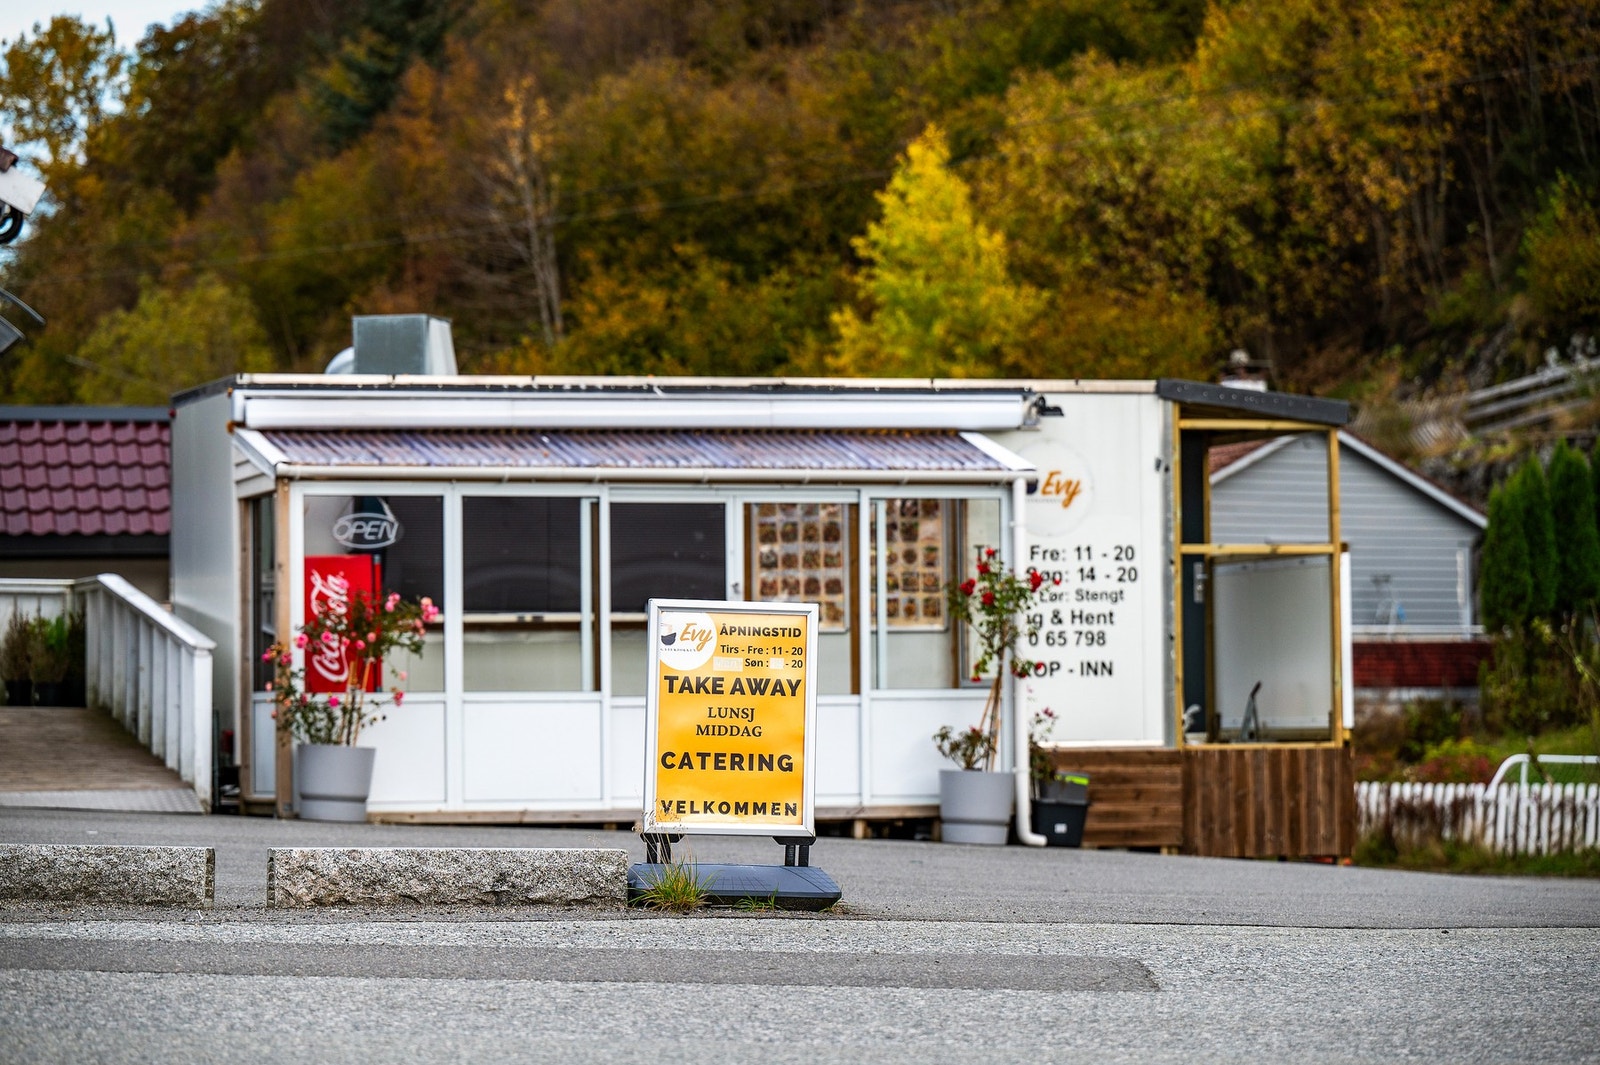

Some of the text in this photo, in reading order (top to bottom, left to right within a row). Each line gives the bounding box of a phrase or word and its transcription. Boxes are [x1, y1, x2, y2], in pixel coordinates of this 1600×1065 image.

[1041, 470, 1081, 509] Evy
[333, 519, 398, 542] OPEN
[1030, 545, 1066, 561] Fre:
[1074, 546, 1092, 561] 11
[1113, 546, 1135, 561] 20
[1078, 567, 1096, 582] 14
[1117, 567, 1138, 582] 20
[1075, 589, 1124, 603] Stengt
[1051, 610, 1063, 625] &
[1071, 610, 1115, 625] Hent
[680, 622, 712, 652] Evy
[720, 623, 802, 638] ÅPNINGSTID
[1046, 631, 1067, 646] 65
[1075, 631, 1106, 646] 798
[720, 644, 739, 654] Tirs
[747, 645, 764, 655] Fre
[771, 646, 783, 655] 11
[791, 647, 803, 656] 20
[745, 658, 764, 667] Søn
[791, 659, 803, 668] 20
[1080, 661, 1113, 676] INN
[664, 675, 802, 697] TAKE AWAY
[708, 706, 755, 722] LUNSJ
[695, 724, 762, 737] MIDDAG
[661, 751, 793, 772] CATERING
[660, 799, 797, 816] VELKOMMEN
